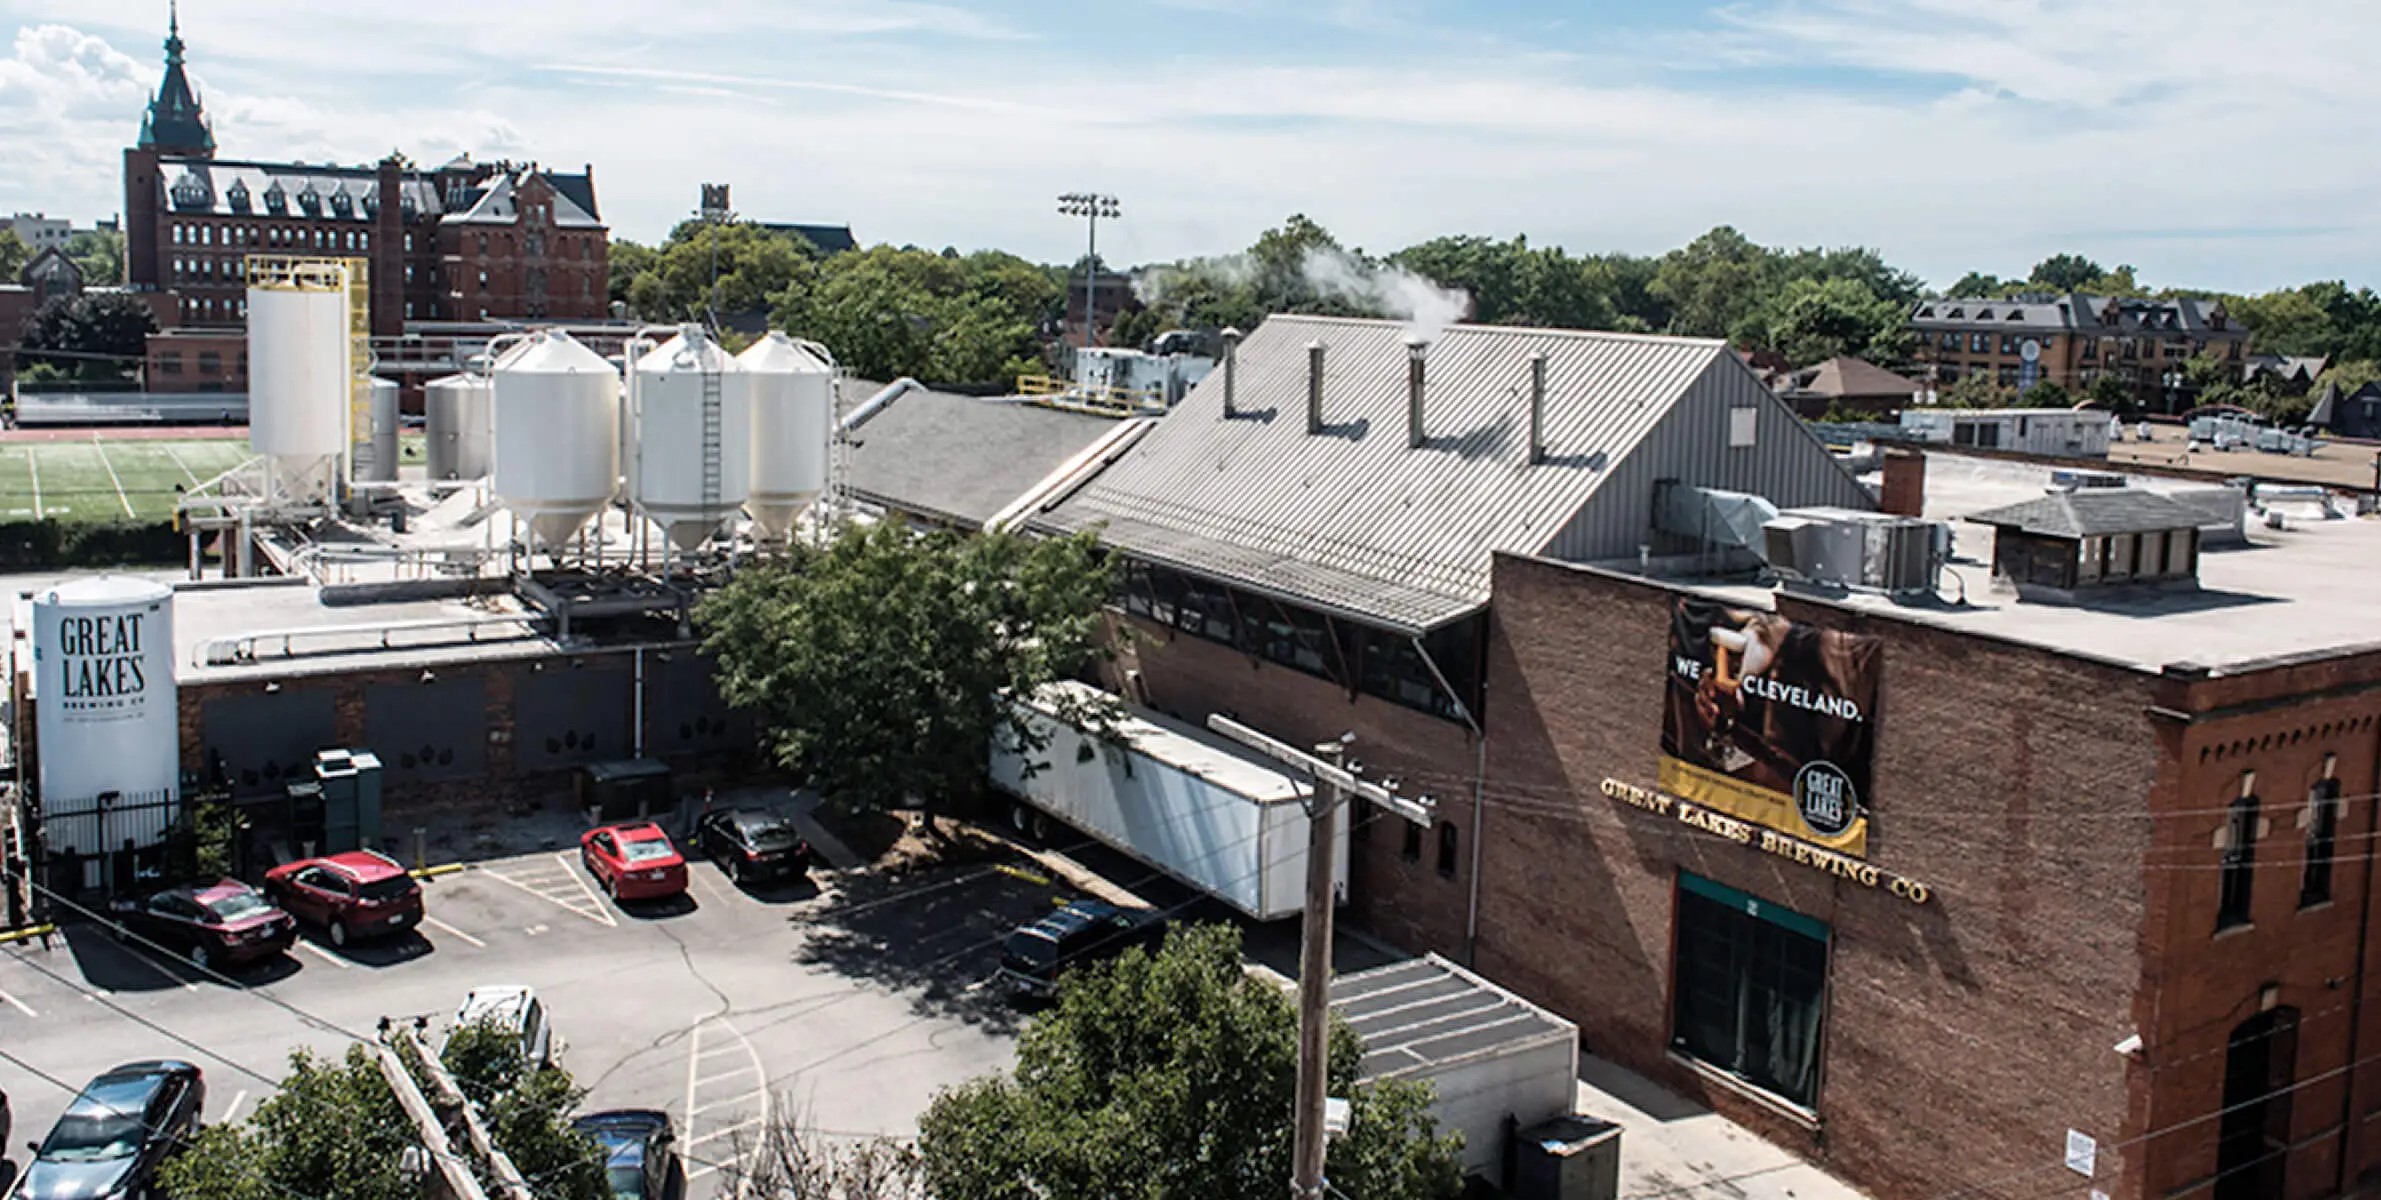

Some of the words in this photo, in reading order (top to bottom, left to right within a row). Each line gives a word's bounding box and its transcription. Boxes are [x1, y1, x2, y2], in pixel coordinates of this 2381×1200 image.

[60, 612, 144, 656] GREAT
[62, 656, 145, 697] LAKES
[1674, 655, 1701, 680] WE
[1742, 675, 1864, 722] CLEVELAND.
[1807, 769, 1843, 799] GREAT
[1807, 791, 1843, 822] LAKES
[1600, 776, 1674, 815] GREAT
[1679, 801, 1752, 845] LAKES
[1760, 829, 1881, 888] BREWING
[1890, 875, 1932, 904] CO
